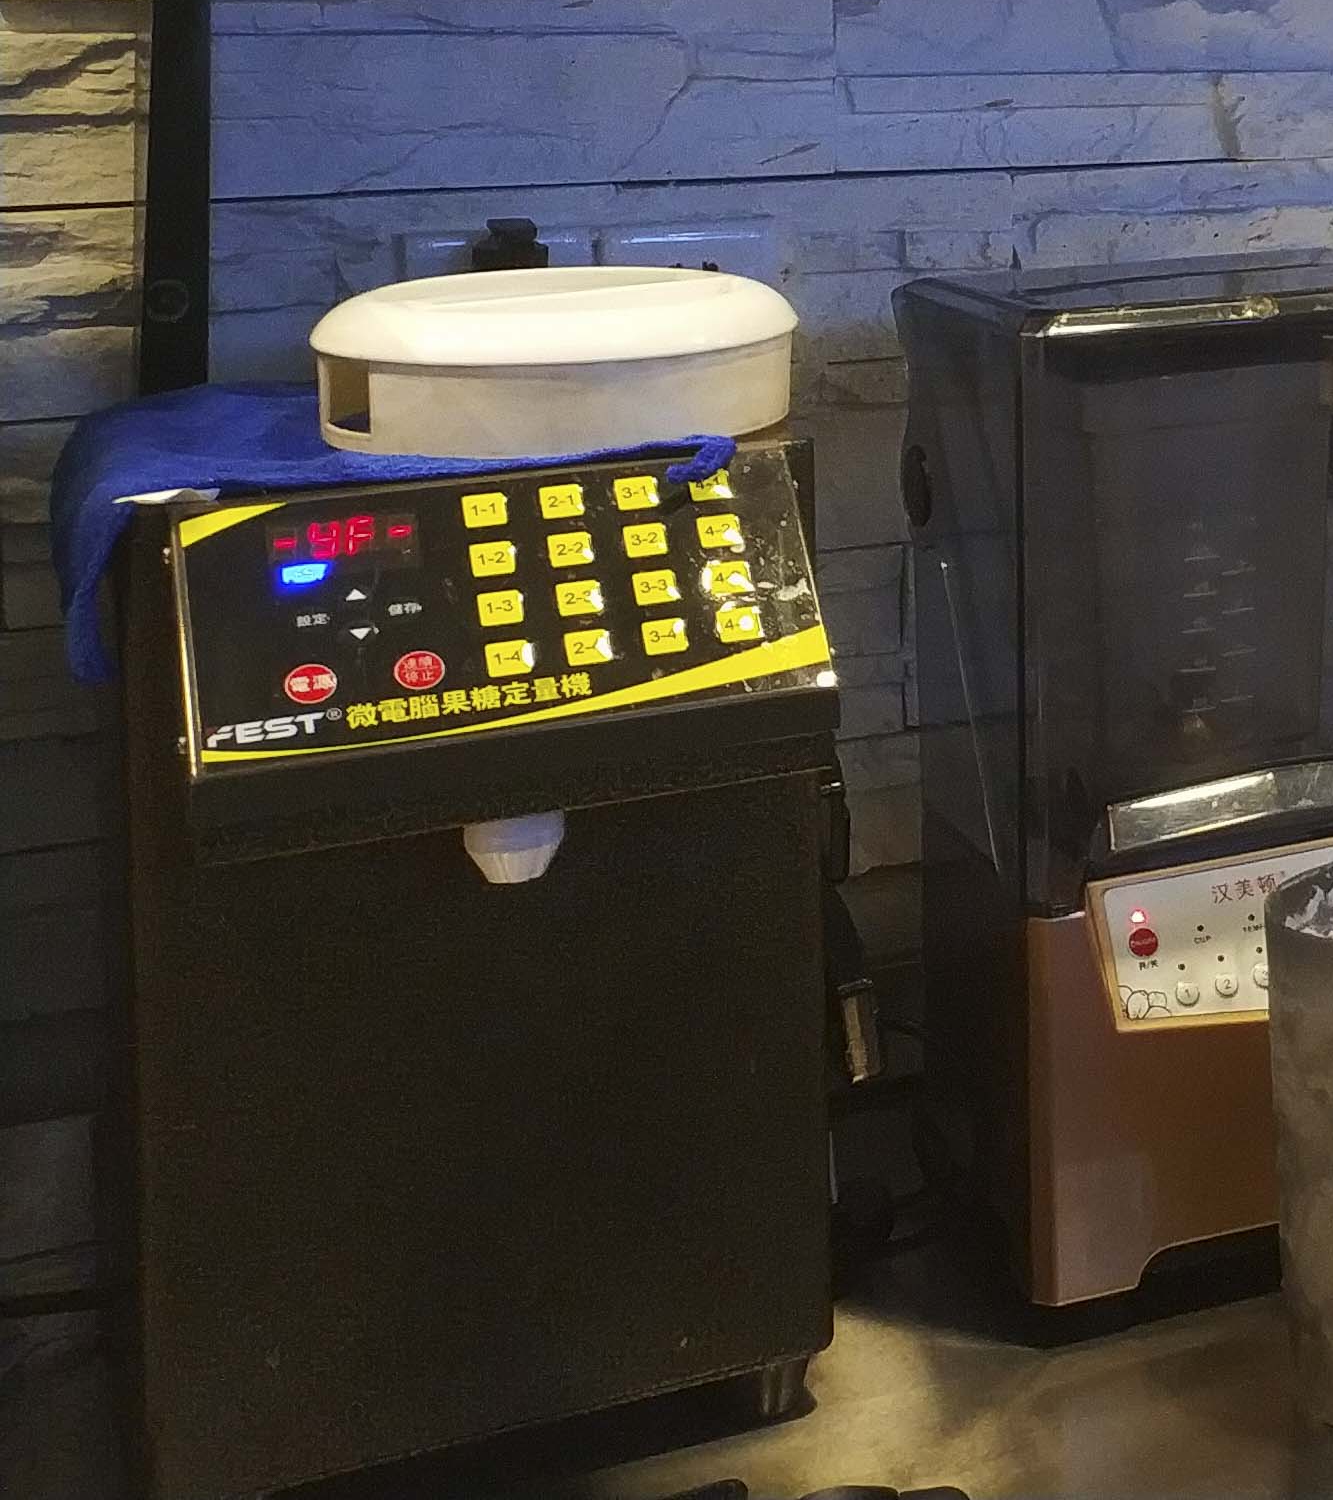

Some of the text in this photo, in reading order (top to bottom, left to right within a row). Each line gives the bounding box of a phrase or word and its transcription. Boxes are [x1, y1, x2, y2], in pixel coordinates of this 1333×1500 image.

[621, 485, 648, 499] 3-1
[547, 494, 575, 508] 2-1
[471, 502, 498, 517] 1-1
[630, 532, 658, 545] 3-2
[555, 541, 584, 556] 2-2
[477, 551, 505, 565] 1-2
[639, 579, 668, 593] 3-3
[485, 599, 513, 614] 1-3
[648, 628, 677, 643] 3-4
[492, 649, 521, 664] 1-4
[345, 671, 593, 730] 微電腦果糖定量機
[205, 710, 326, 748] FEST
[1211, 873, 1281, 904] 汉美顿
